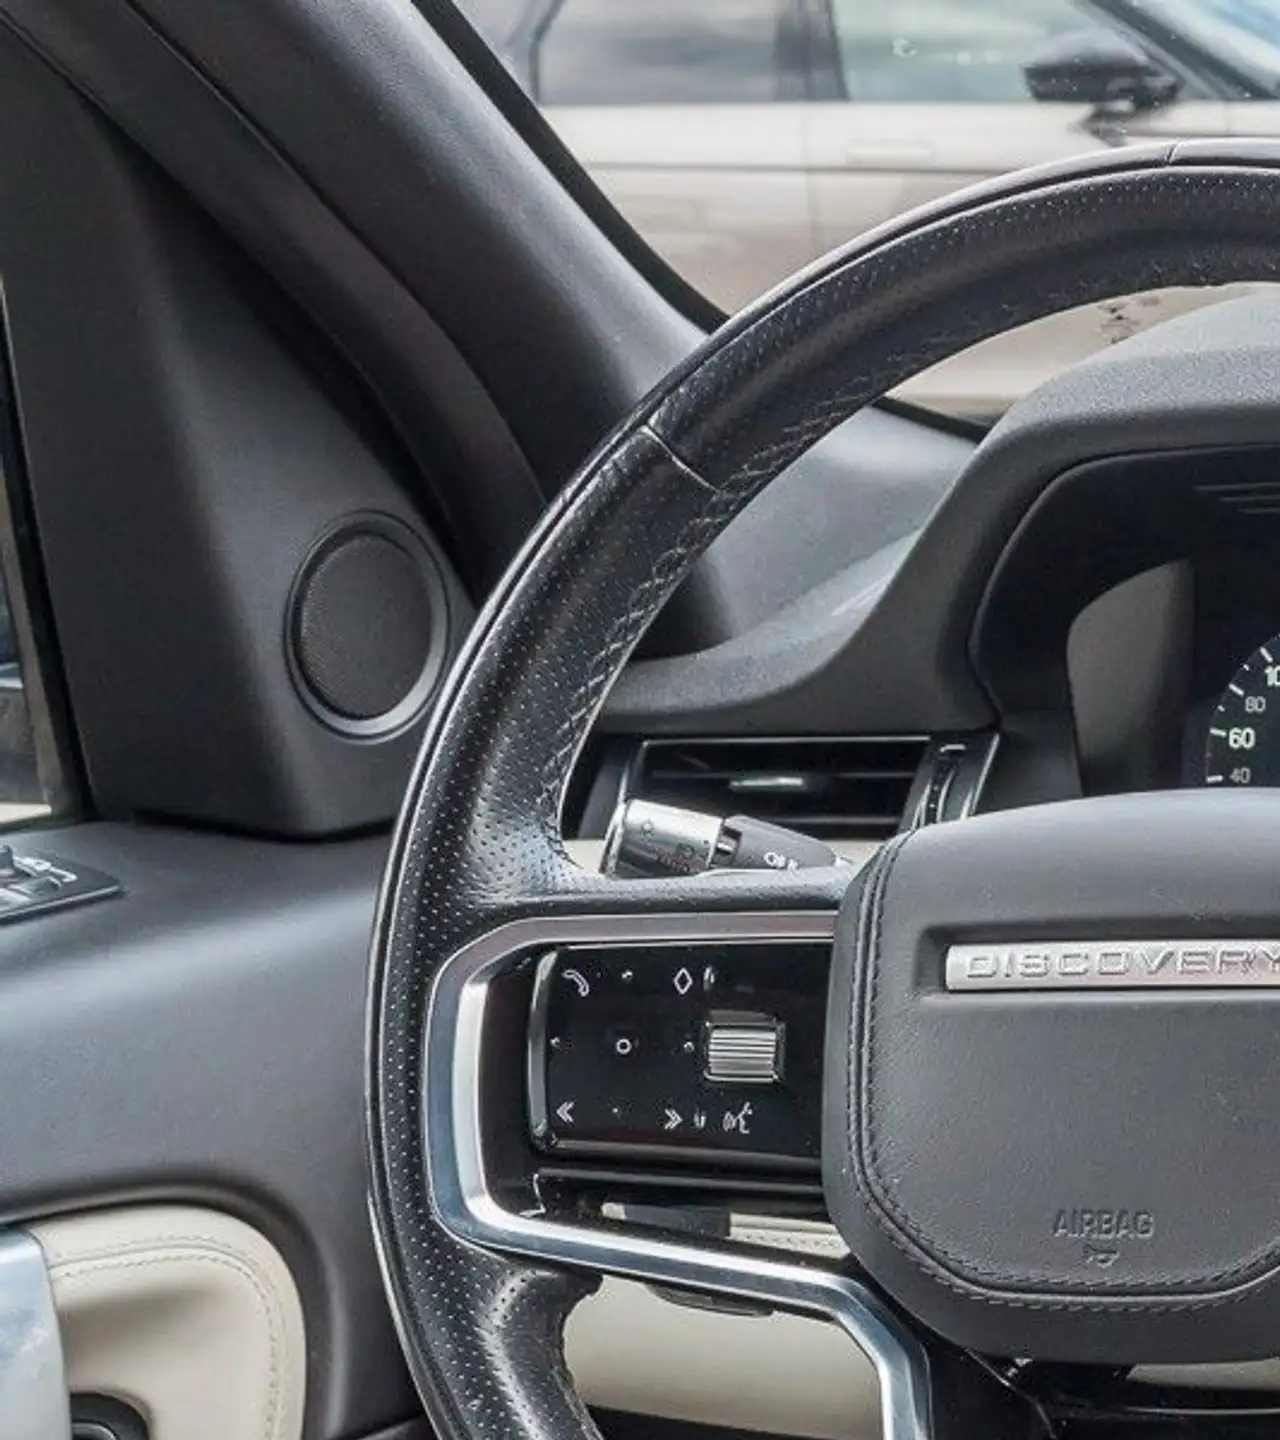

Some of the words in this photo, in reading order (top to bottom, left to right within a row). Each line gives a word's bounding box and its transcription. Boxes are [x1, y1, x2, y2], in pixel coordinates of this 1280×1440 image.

[1245, 696, 1267, 713] 80
[1228, 728, 1256, 749] 60
[1229, 767, 1251, 784] 40
[1051, 1209, 1154, 1239] AIRBAG
